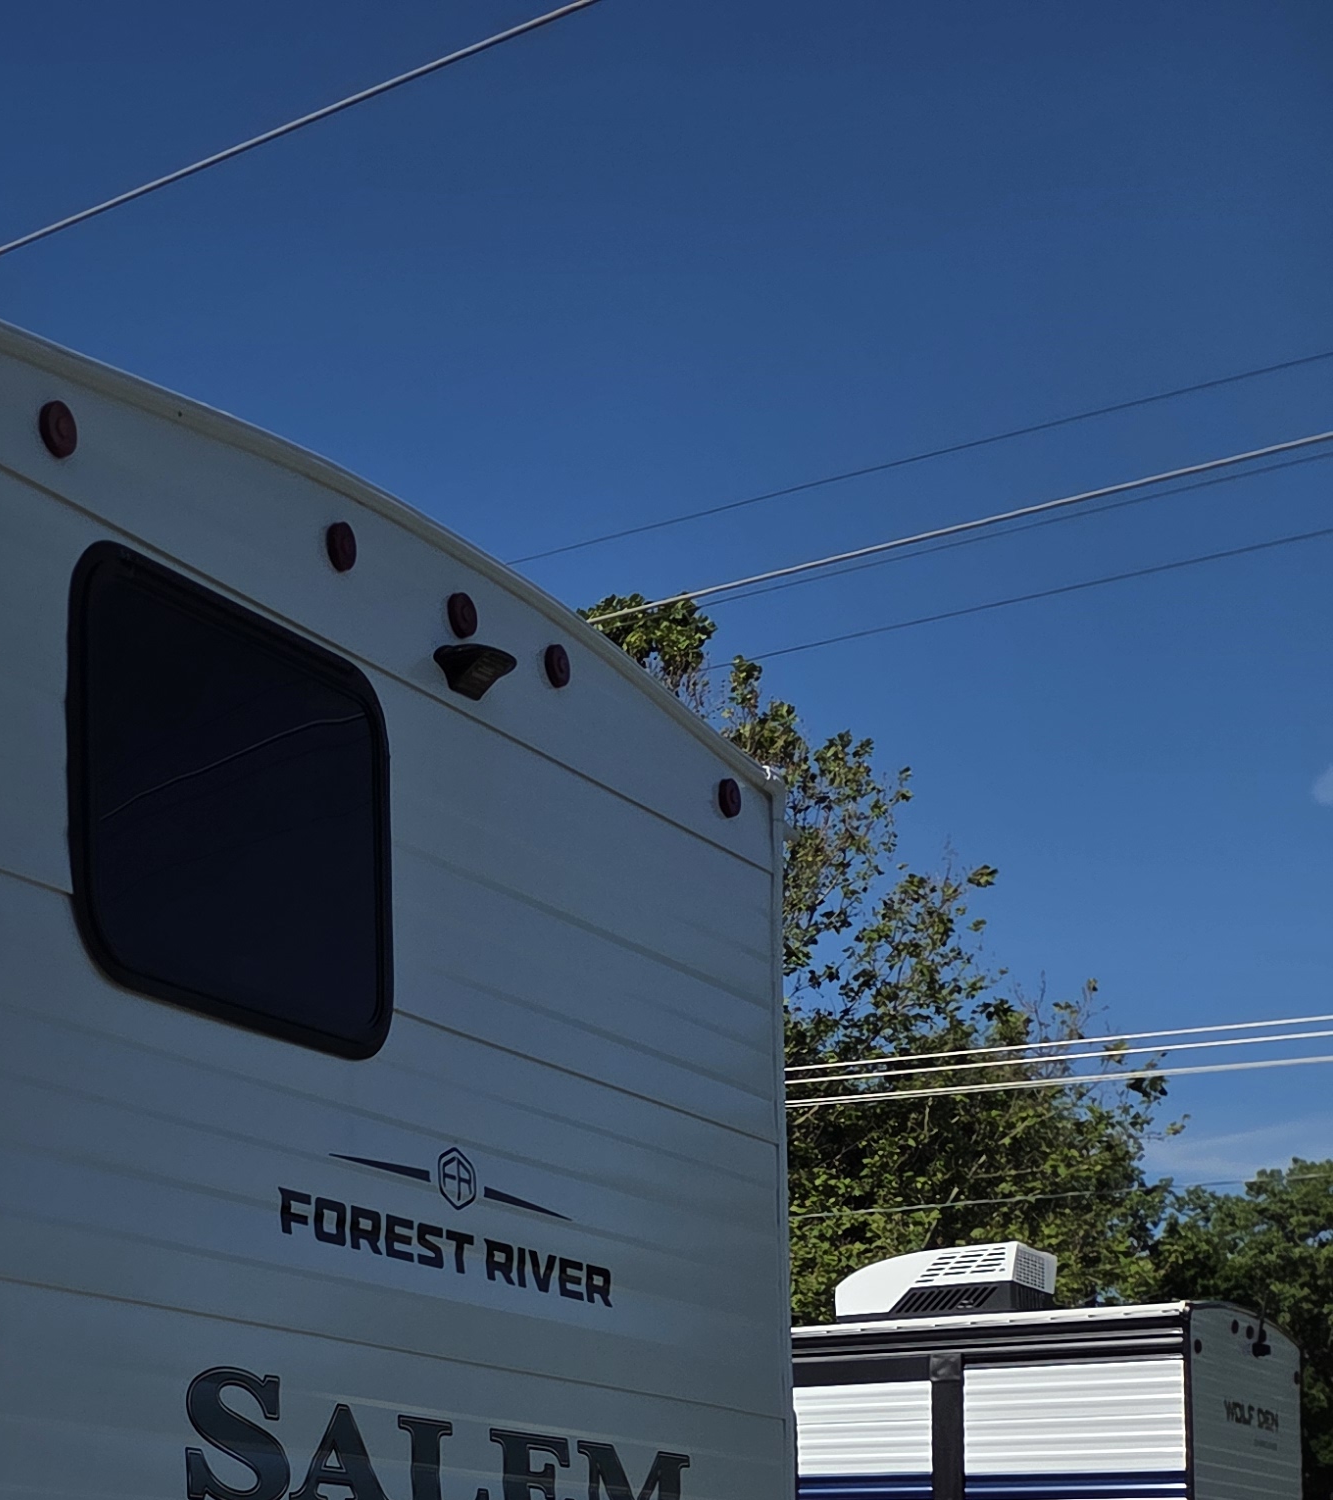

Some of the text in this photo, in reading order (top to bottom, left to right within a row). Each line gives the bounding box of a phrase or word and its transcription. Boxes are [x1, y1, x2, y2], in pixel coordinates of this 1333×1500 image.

[277, 1186, 614, 1308] FOREST RIVER
[1223, 1397, 1255, 1425] WOLF
